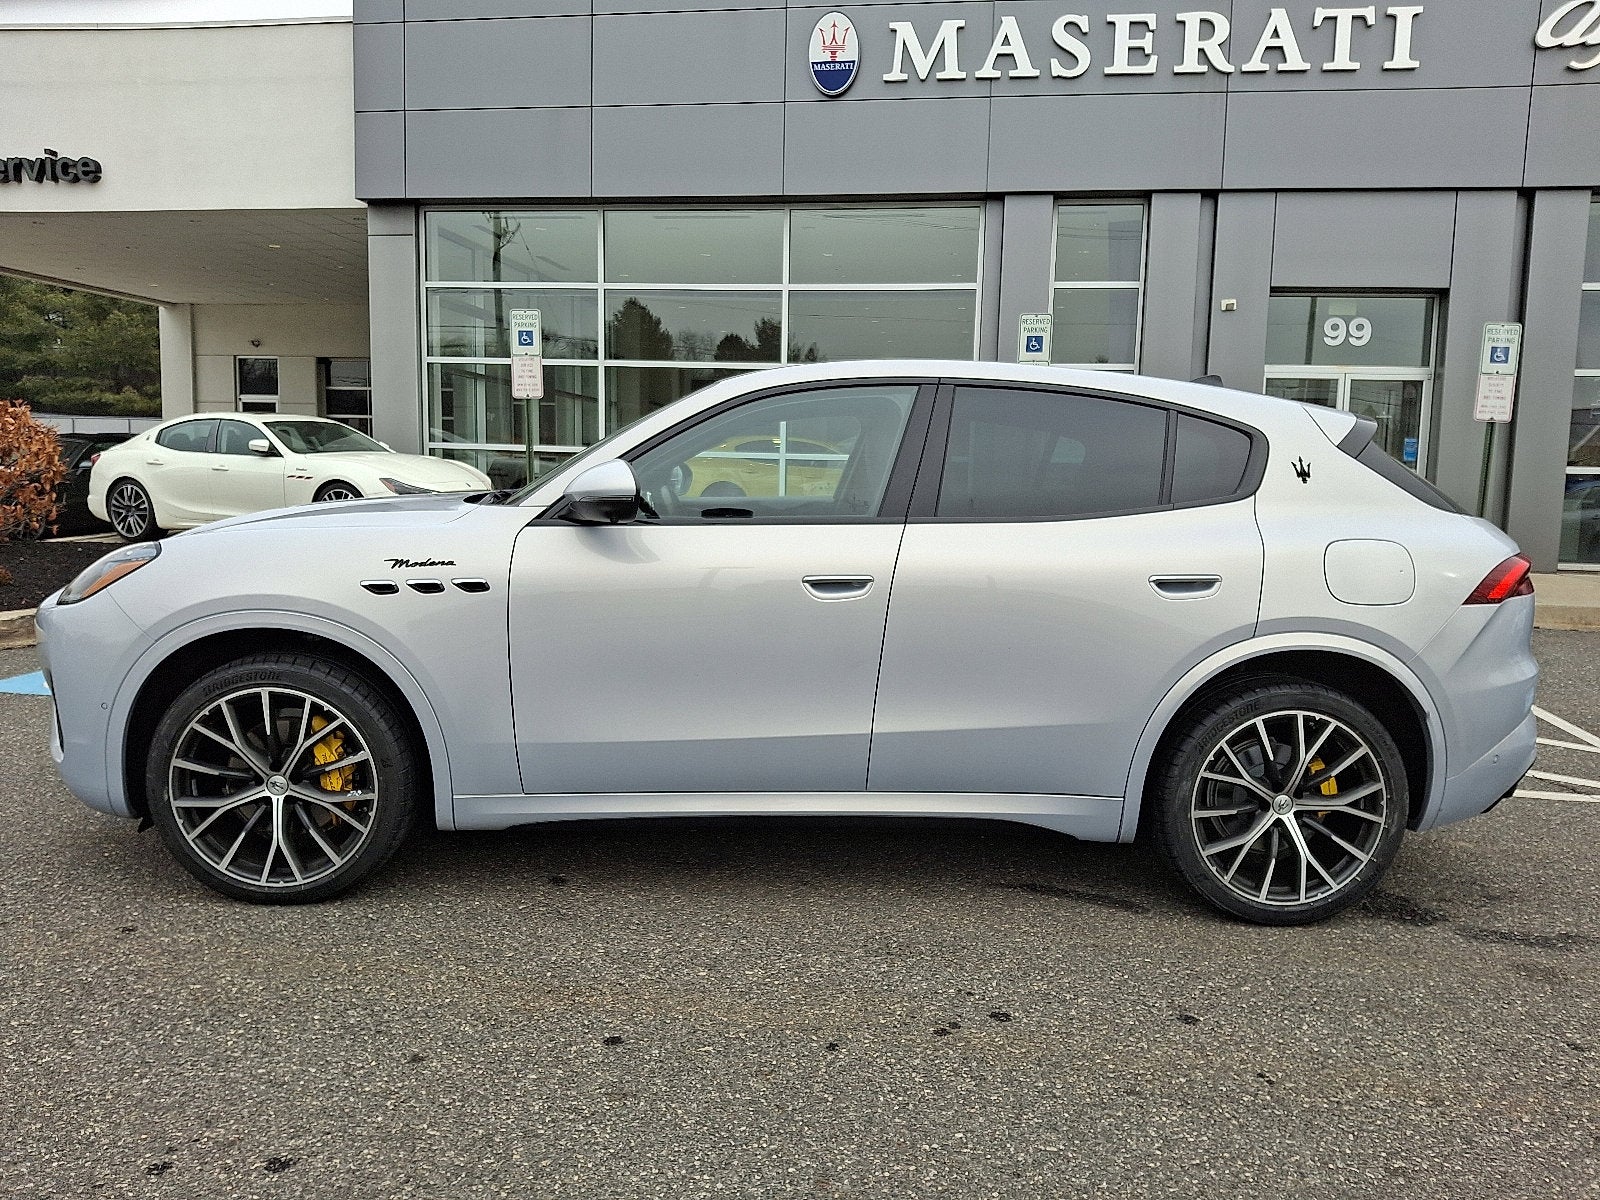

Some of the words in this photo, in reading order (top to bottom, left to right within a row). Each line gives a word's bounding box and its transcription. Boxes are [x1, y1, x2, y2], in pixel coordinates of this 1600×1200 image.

[883, 5, 1423, 82] MASERATI
[813, 62, 855, 71] MASERATI
[512, 313, 538, 321] RESERVED
[513, 321, 537, 329] PARKING
[1021, 318, 1051, 326] RESERVED
[1023, 326, 1048, 334] PARKING
[1323, 317, 1372, 346] 99
[1487, 328, 1519, 336] RESERVED
[1487, 336, 1516, 345] PARKING
[383, 557, 456, 569] Modena
